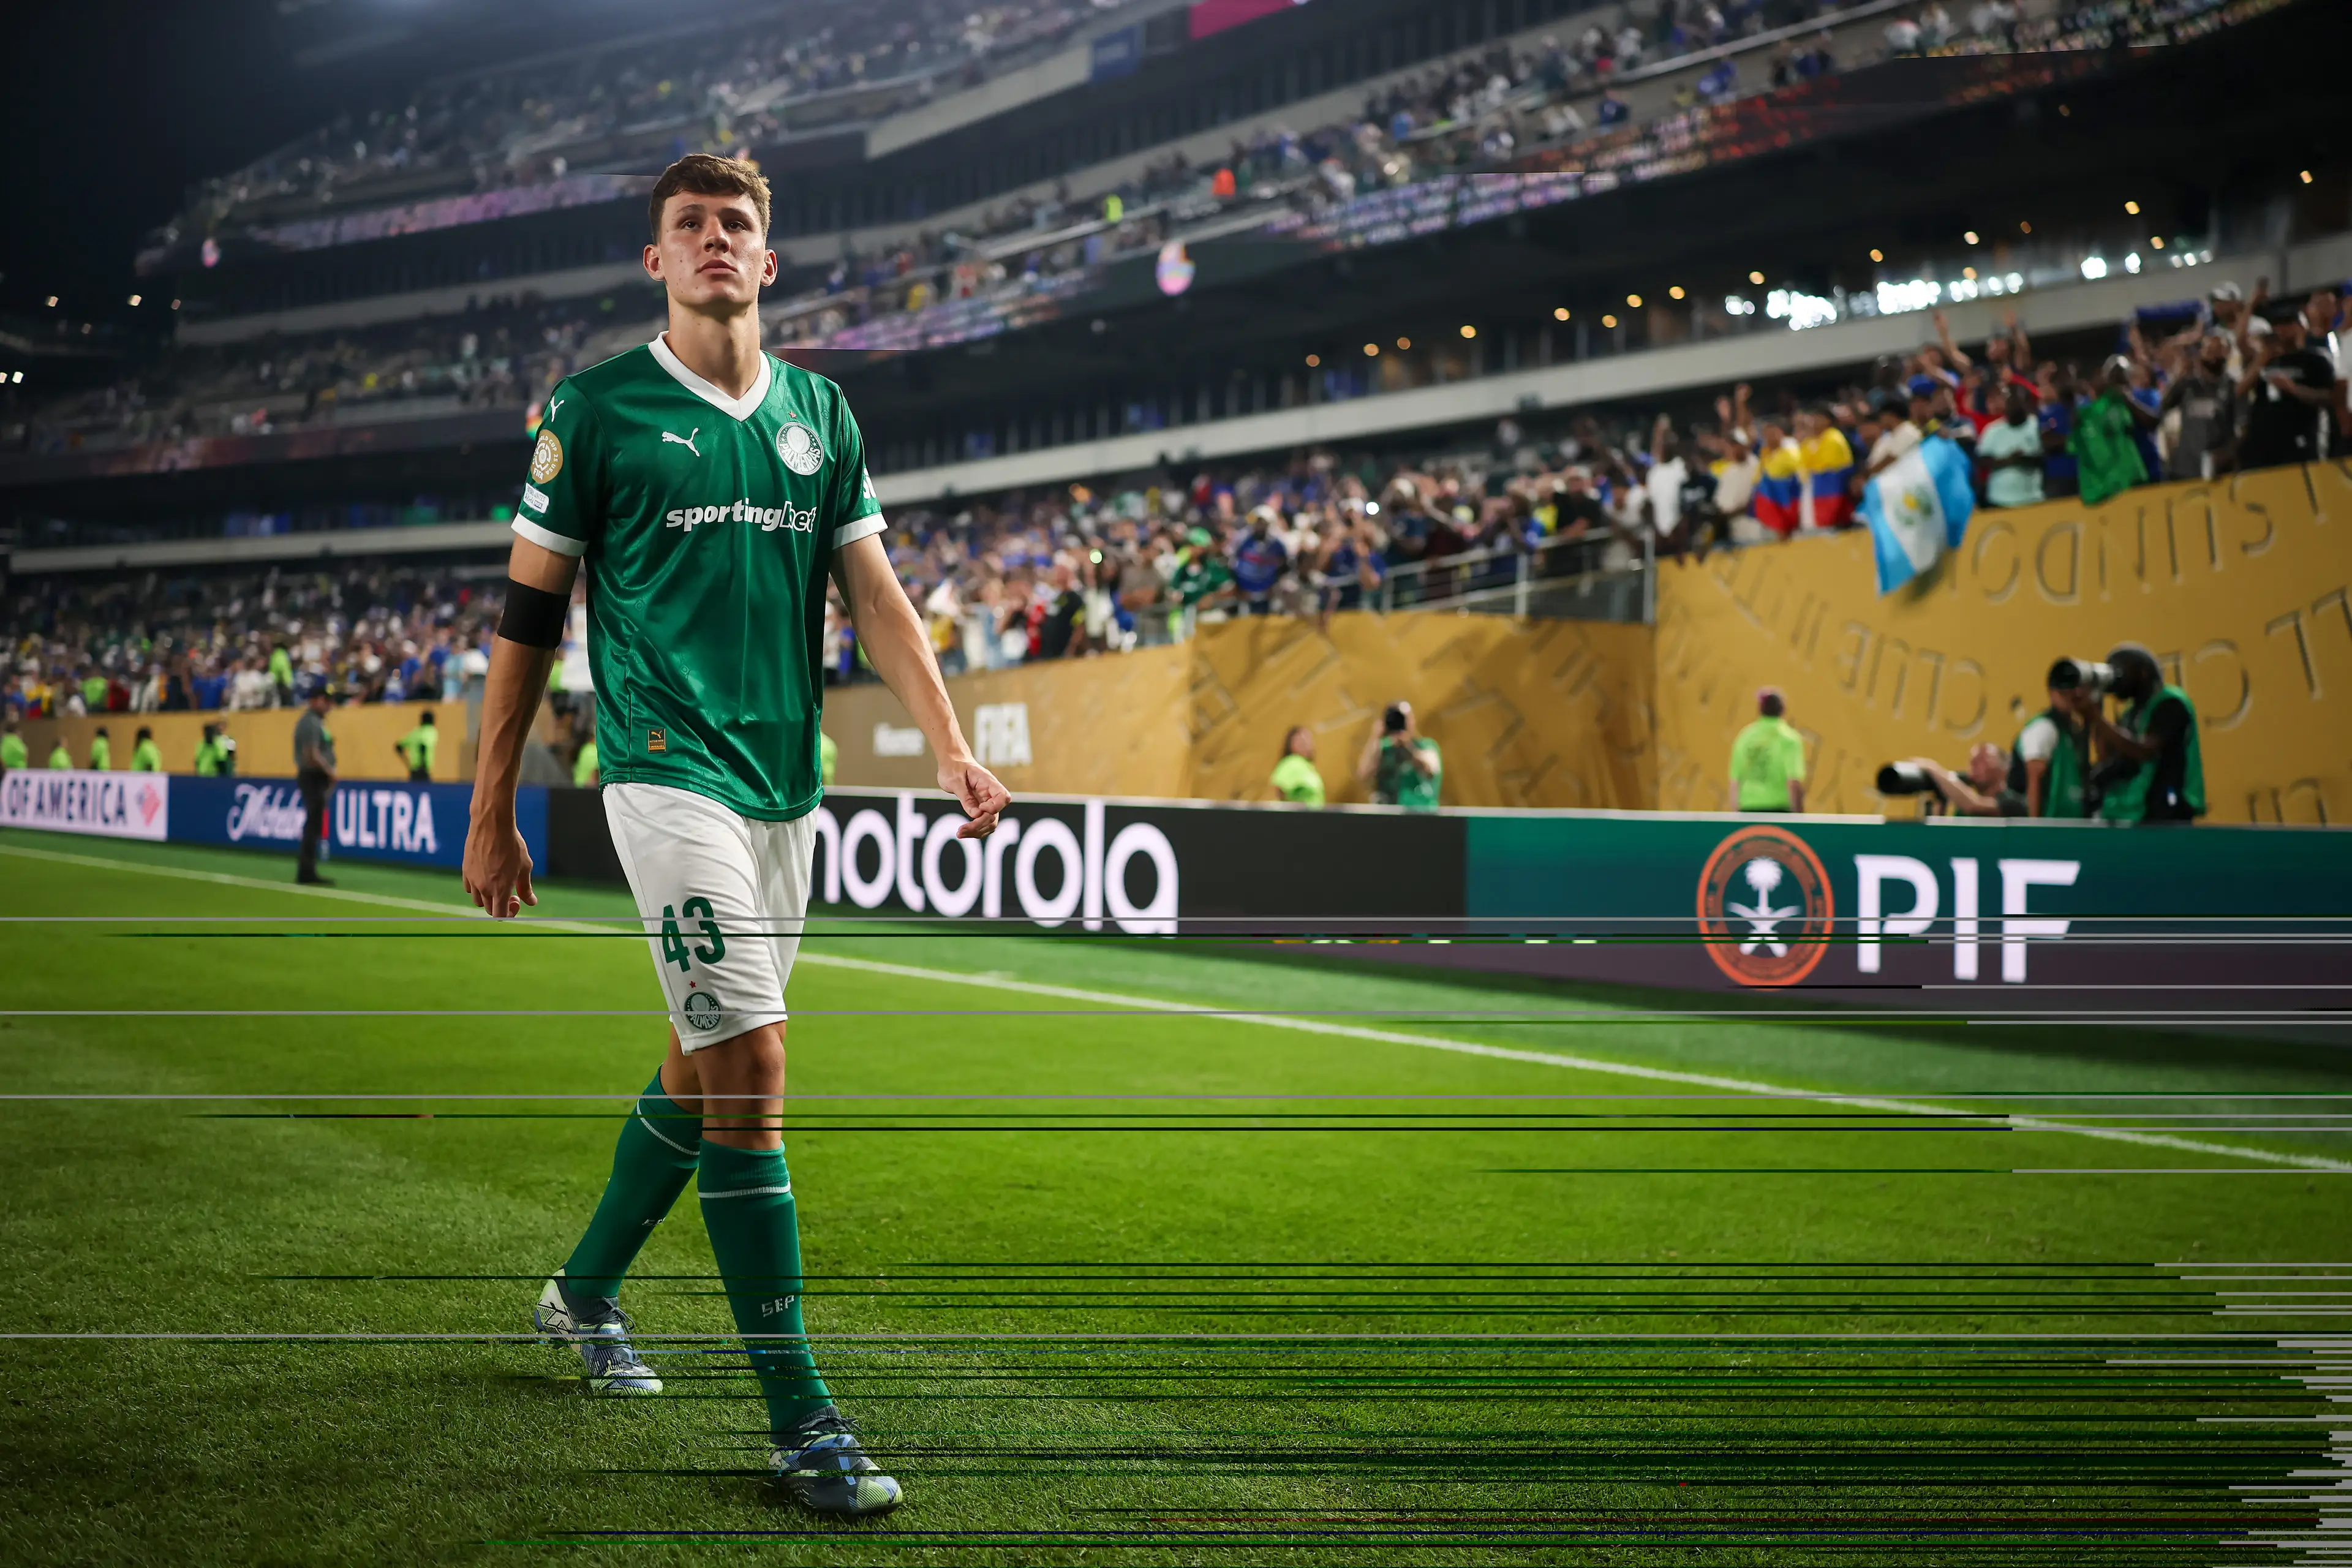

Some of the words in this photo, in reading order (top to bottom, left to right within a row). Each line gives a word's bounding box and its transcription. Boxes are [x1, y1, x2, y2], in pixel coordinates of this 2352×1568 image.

[549, 439, 557, 451] CUP
[553, 454, 559, 462] 25
[533, 467, 544, 480] FIFA
[545, 464, 556, 475] USA
[666, 497, 817, 533] sportingbet
[33, 778, 127, 824] AMERICA
[336, 788, 438, 854] ULTRA
[1854, 854, 2081, 984] PIF
[662, 896, 726, 973] 43
[761, 1295, 794, 1317] SEP
